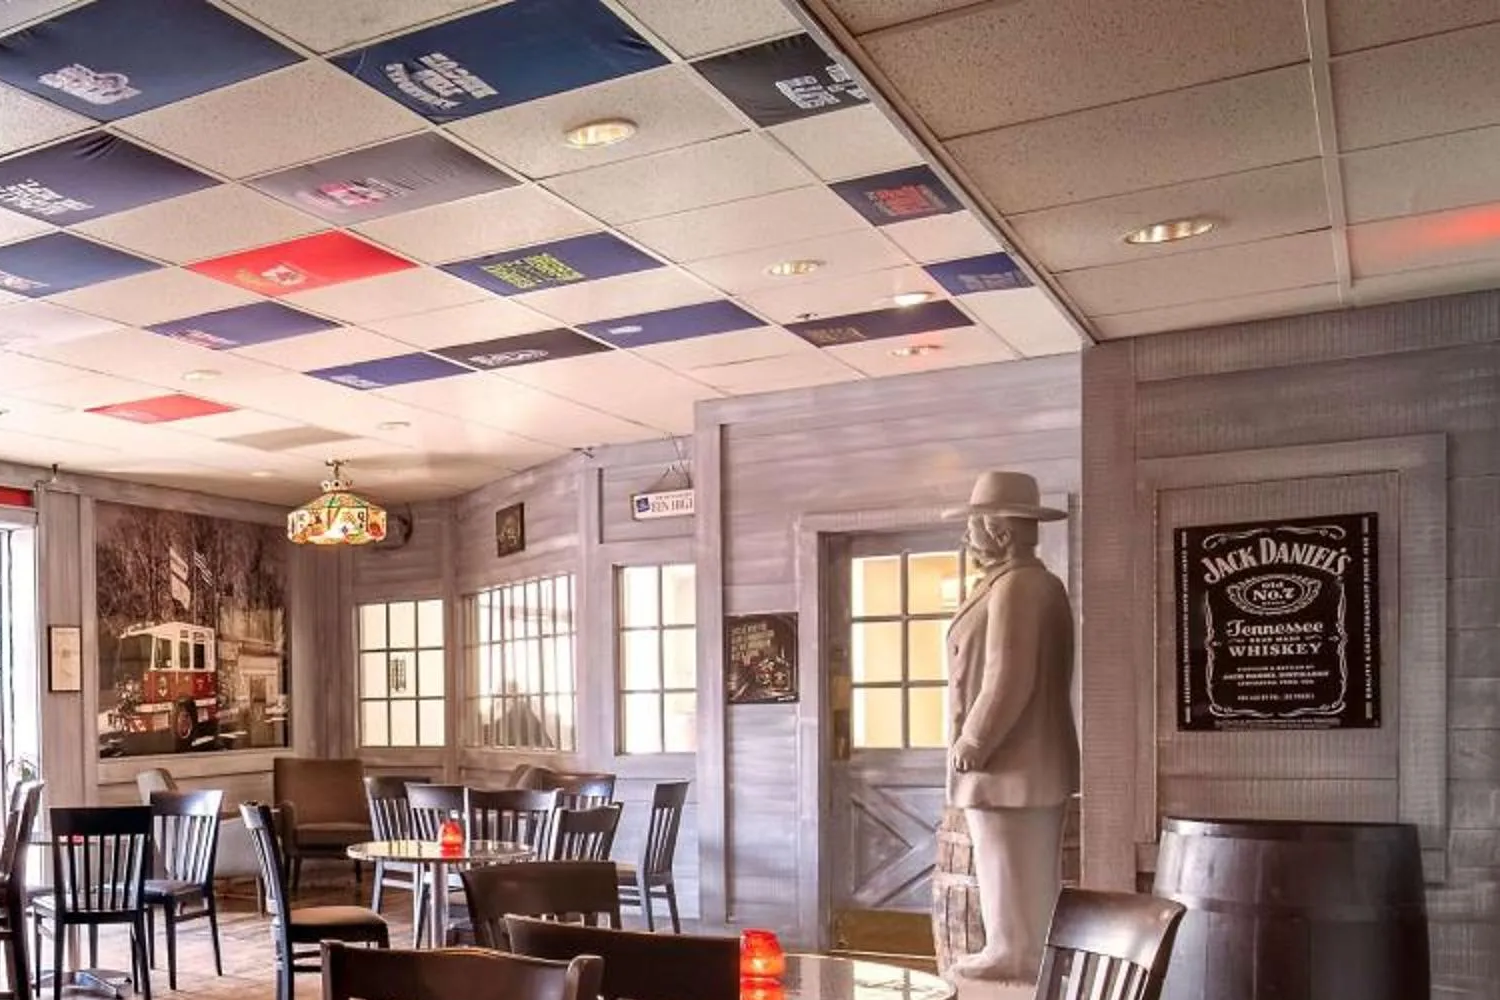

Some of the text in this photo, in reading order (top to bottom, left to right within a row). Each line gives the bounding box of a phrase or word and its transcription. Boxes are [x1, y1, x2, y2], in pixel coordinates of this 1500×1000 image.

[1202, 546, 1258, 583] JACK
[1226, 619, 1324, 637] Tennessee
[1228, 643, 1322, 657] WHISKEY
